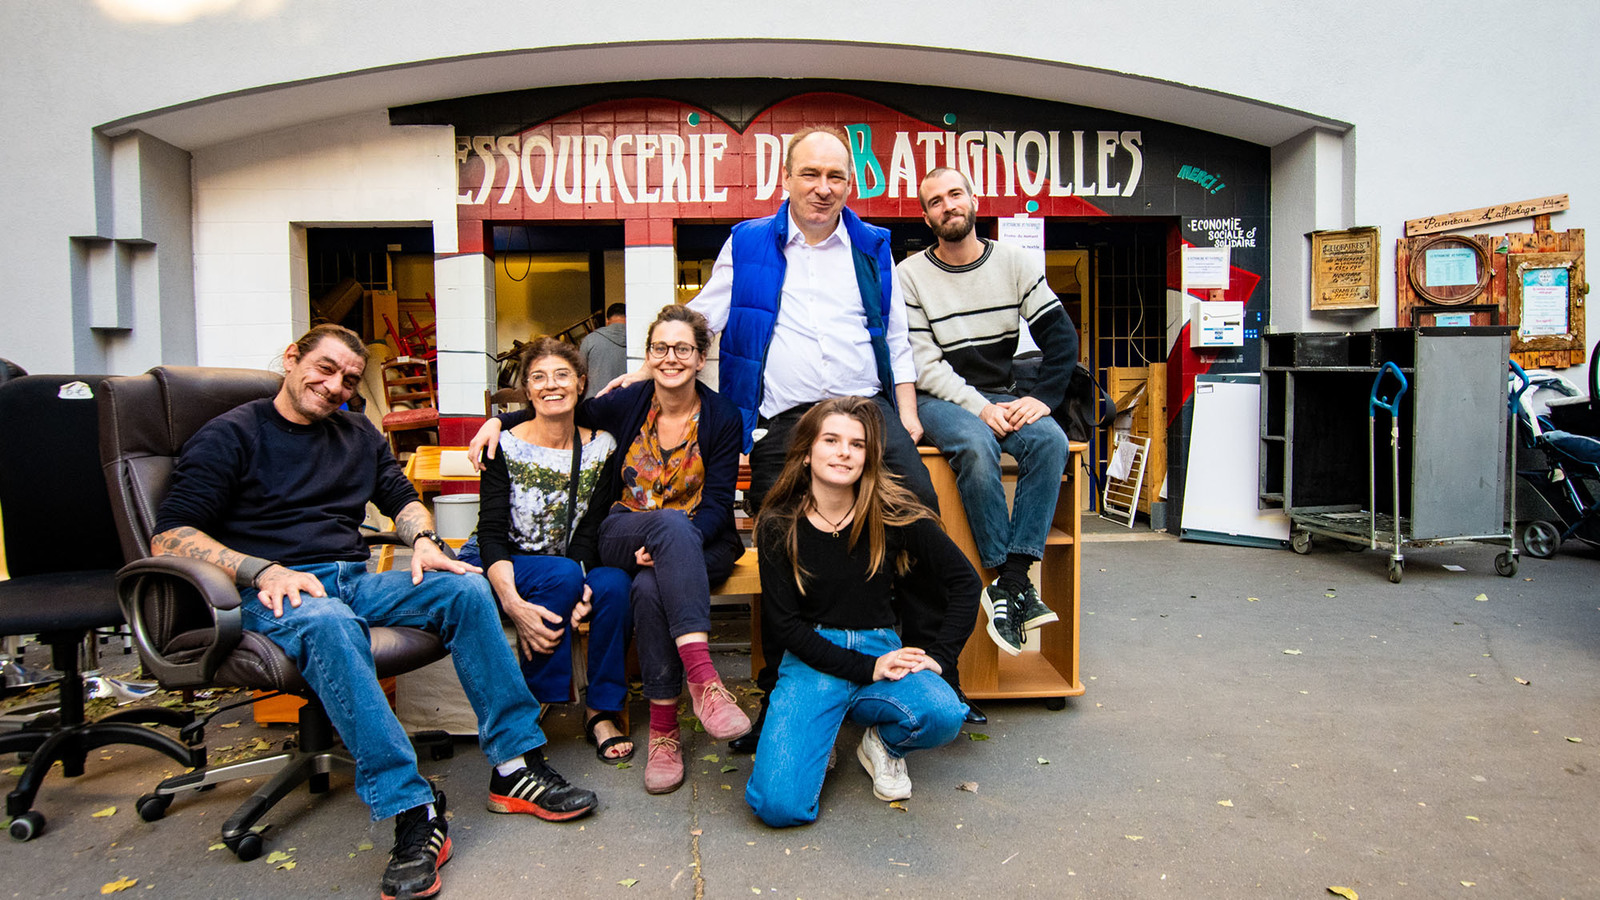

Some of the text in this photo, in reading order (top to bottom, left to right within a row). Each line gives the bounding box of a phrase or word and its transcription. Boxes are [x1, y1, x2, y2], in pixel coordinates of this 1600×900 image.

[844, 113, 1143, 200] BATIGNOLLES
[1424, 216, 1471, 230] Panneau
[1208, 230, 1244, 240] SOCIALE
